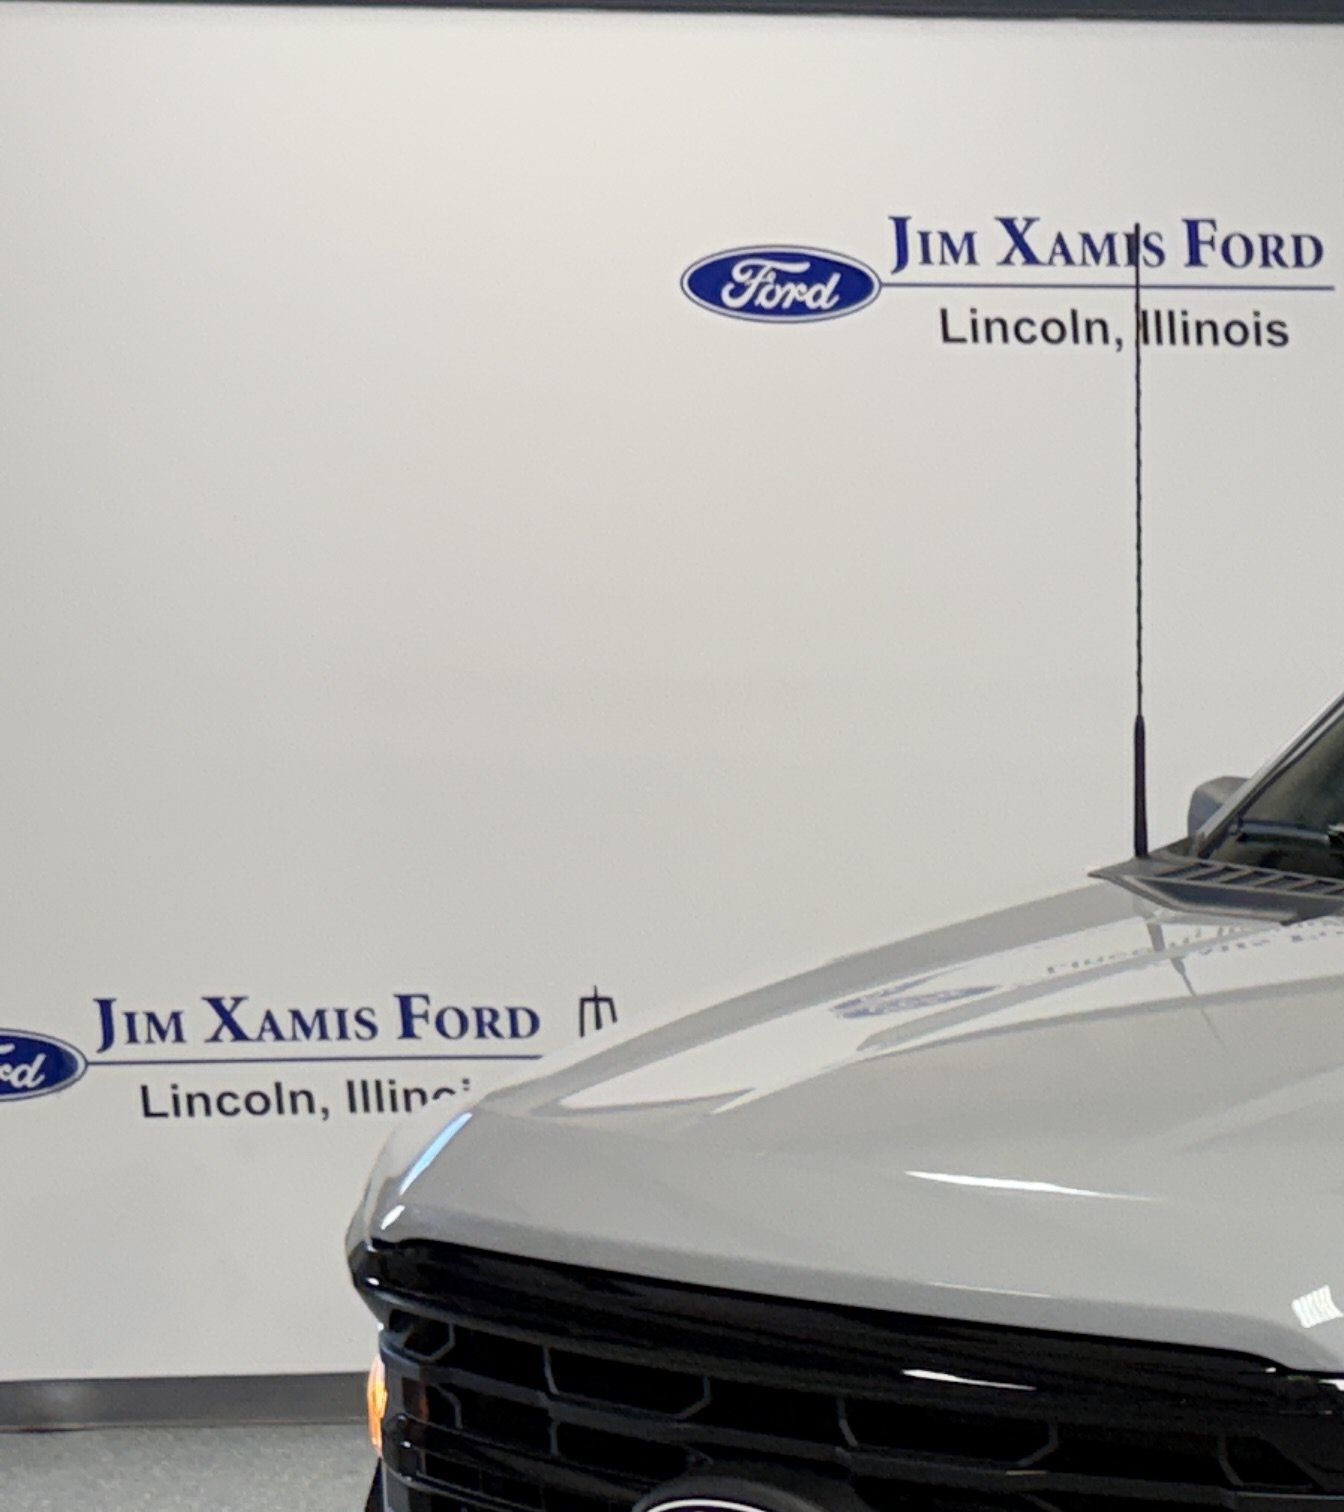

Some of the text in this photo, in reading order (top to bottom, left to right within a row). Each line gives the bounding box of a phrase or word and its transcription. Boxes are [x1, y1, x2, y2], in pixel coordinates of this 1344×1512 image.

[888, 216, 1325, 275] JIM XAMIS FORD
[721, 258, 841, 309] Ford
[940, 307, 1290, 352] Lincoln, Illinois
[93, 993, 541, 1053] JIM XAMIS FORD
[140, 1078, 471, 1122] Lincoln, Illin
